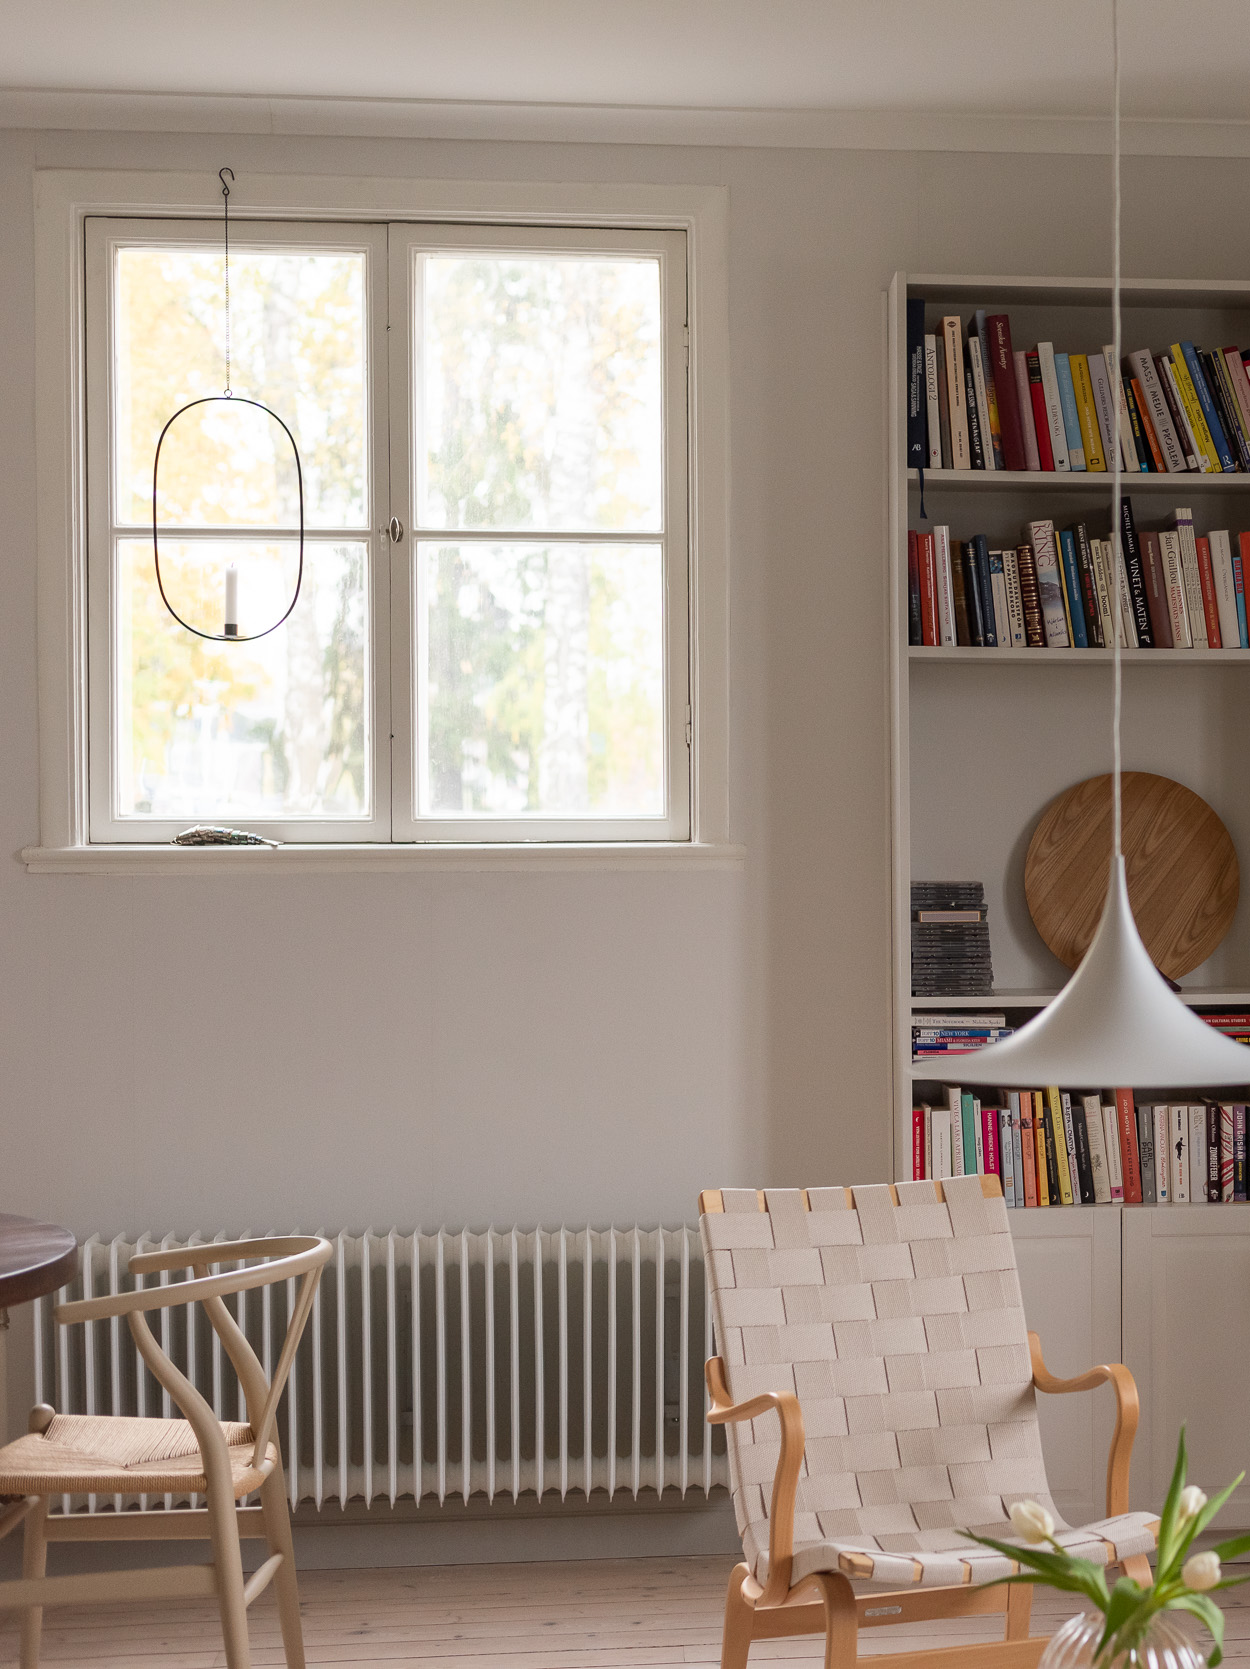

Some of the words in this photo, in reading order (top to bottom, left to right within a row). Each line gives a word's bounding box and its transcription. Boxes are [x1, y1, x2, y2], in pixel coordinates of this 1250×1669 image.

[996, 322, 1005, 344] Svenska
[927, 348, 936, 392] ANTOLOGI
[999, 346, 1007, 369] Äventyr
[1098, 378, 1106, 405] GULLIVERS
[1150, 391, 1164, 417] MEDIE
[1163, 429, 1179, 467] PROBLEM
[1033, 525, 1050, 566] KING
[1045, 523, 1056, 566] STEPHEN
[1080, 544, 1088, 569] HEMINGWAY
[1165, 535, 1174, 550] Jan
[1126, 531, 1134, 553] JAMAIS
[1130, 558, 1141, 588] VINET
[1136, 597, 1148, 630] MATEN
[1167, 551, 1178, 584] Guillou
[1013, 587, 1022, 628] DAHLSTRÖM
[1101, 596, 1110, 617] boom!
[1012, 1133, 1020, 1150] gossip
[1057, 1134, 1067, 1177] Hummerfesten
[1209, 1147, 1218, 1181] ZOMBIEFEBER
